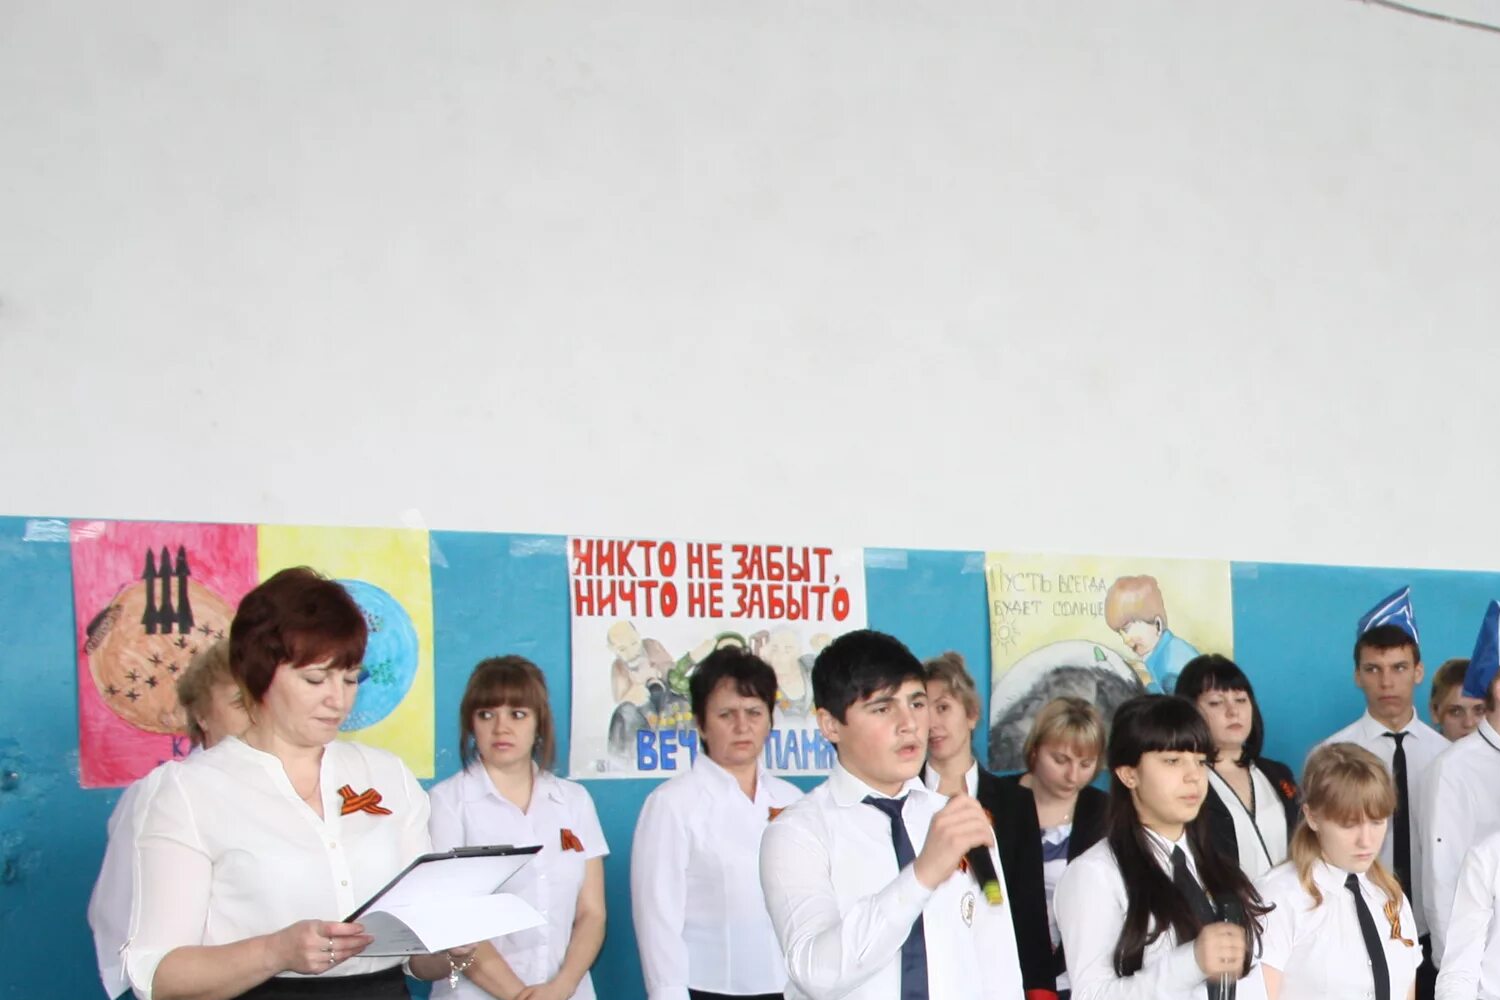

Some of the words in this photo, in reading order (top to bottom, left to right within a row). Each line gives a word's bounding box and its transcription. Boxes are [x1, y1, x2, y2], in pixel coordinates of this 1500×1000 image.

[572, 538, 677, 578] НИКТО
[686, 542, 723, 579] НЕ
[731, 544, 841, 585] ЗАБЫТ,
[989, 563, 1052, 593] ПУСТЬ
[1058, 573, 1107, 594] ВСЕГДА
[574, 579, 678, 618] НИЧТО
[687, 582, 723, 618] НЕ
[730, 583, 850, 622] ЗАБЫТО
[993, 599, 1042, 617] БУДЕТ
[636, 729, 698, 771] ВЕЧ
[764, 729, 835, 770] ПАМЯ
